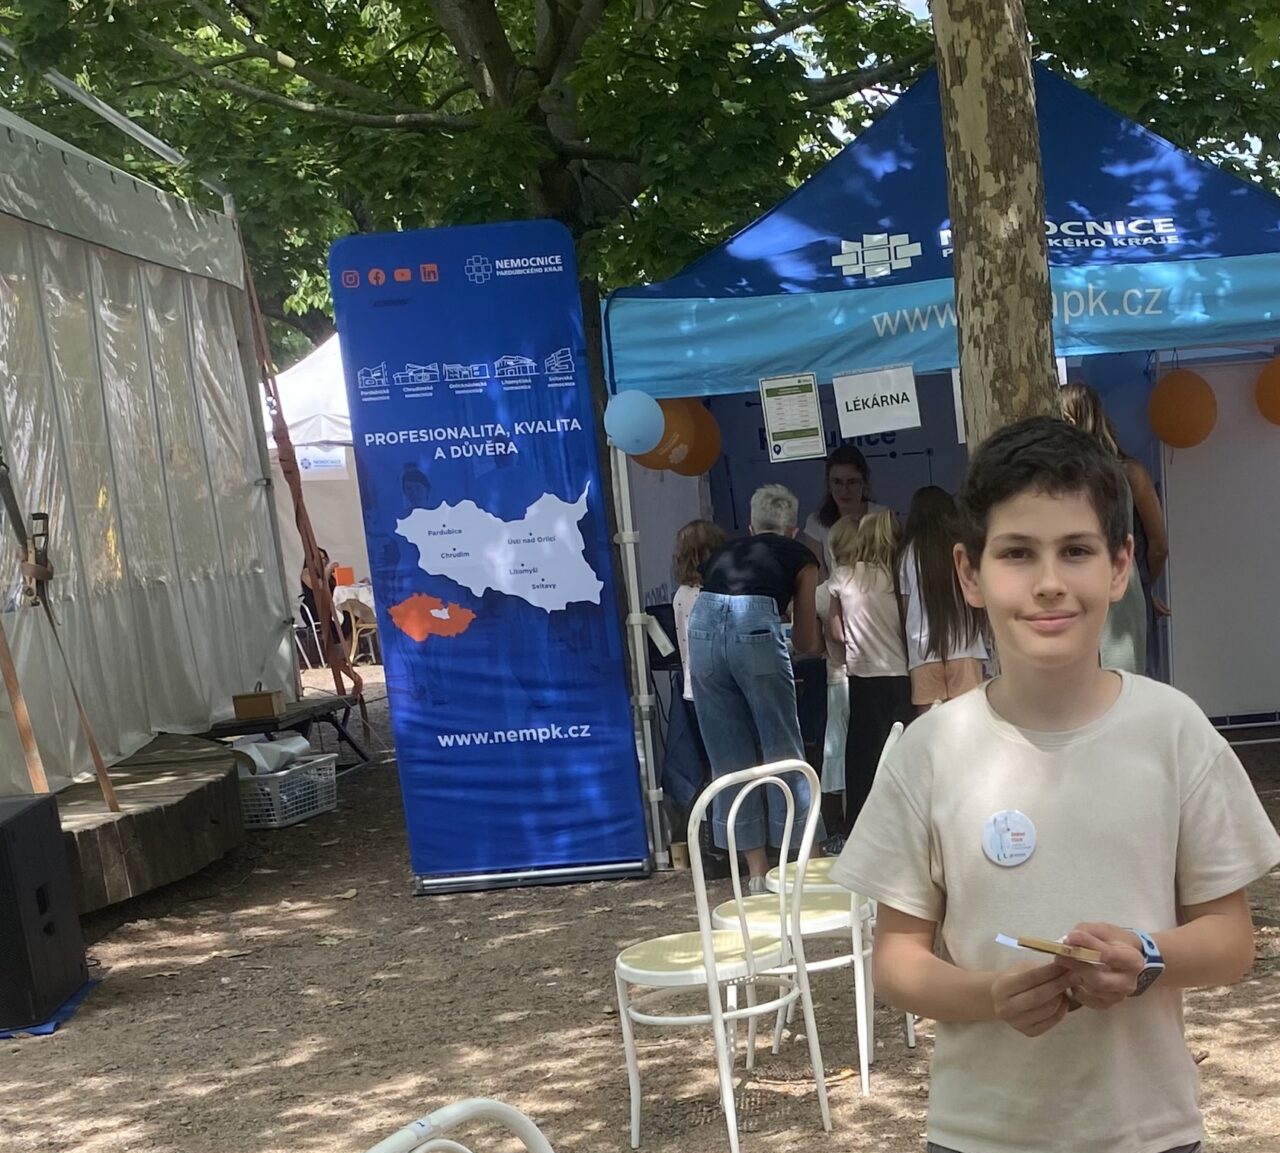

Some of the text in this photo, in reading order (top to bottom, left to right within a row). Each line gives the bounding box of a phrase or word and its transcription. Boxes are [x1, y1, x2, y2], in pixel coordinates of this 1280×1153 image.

[1113, 235, 1180, 247] KRAJE
[495, 255, 562, 269] NEMOCNICE
[845, 391, 911, 413] LÉKÁRNA
[365, 418, 582, 446] PROFESIONALITA, KVALITA
[434, 440, 519, 460] A DŮVĚRA
[428, 529, 462, 537] Pardubice
[440, 552, 470, 560] Chrudim
[437, 723, 591, 748] www.nempk.cz
